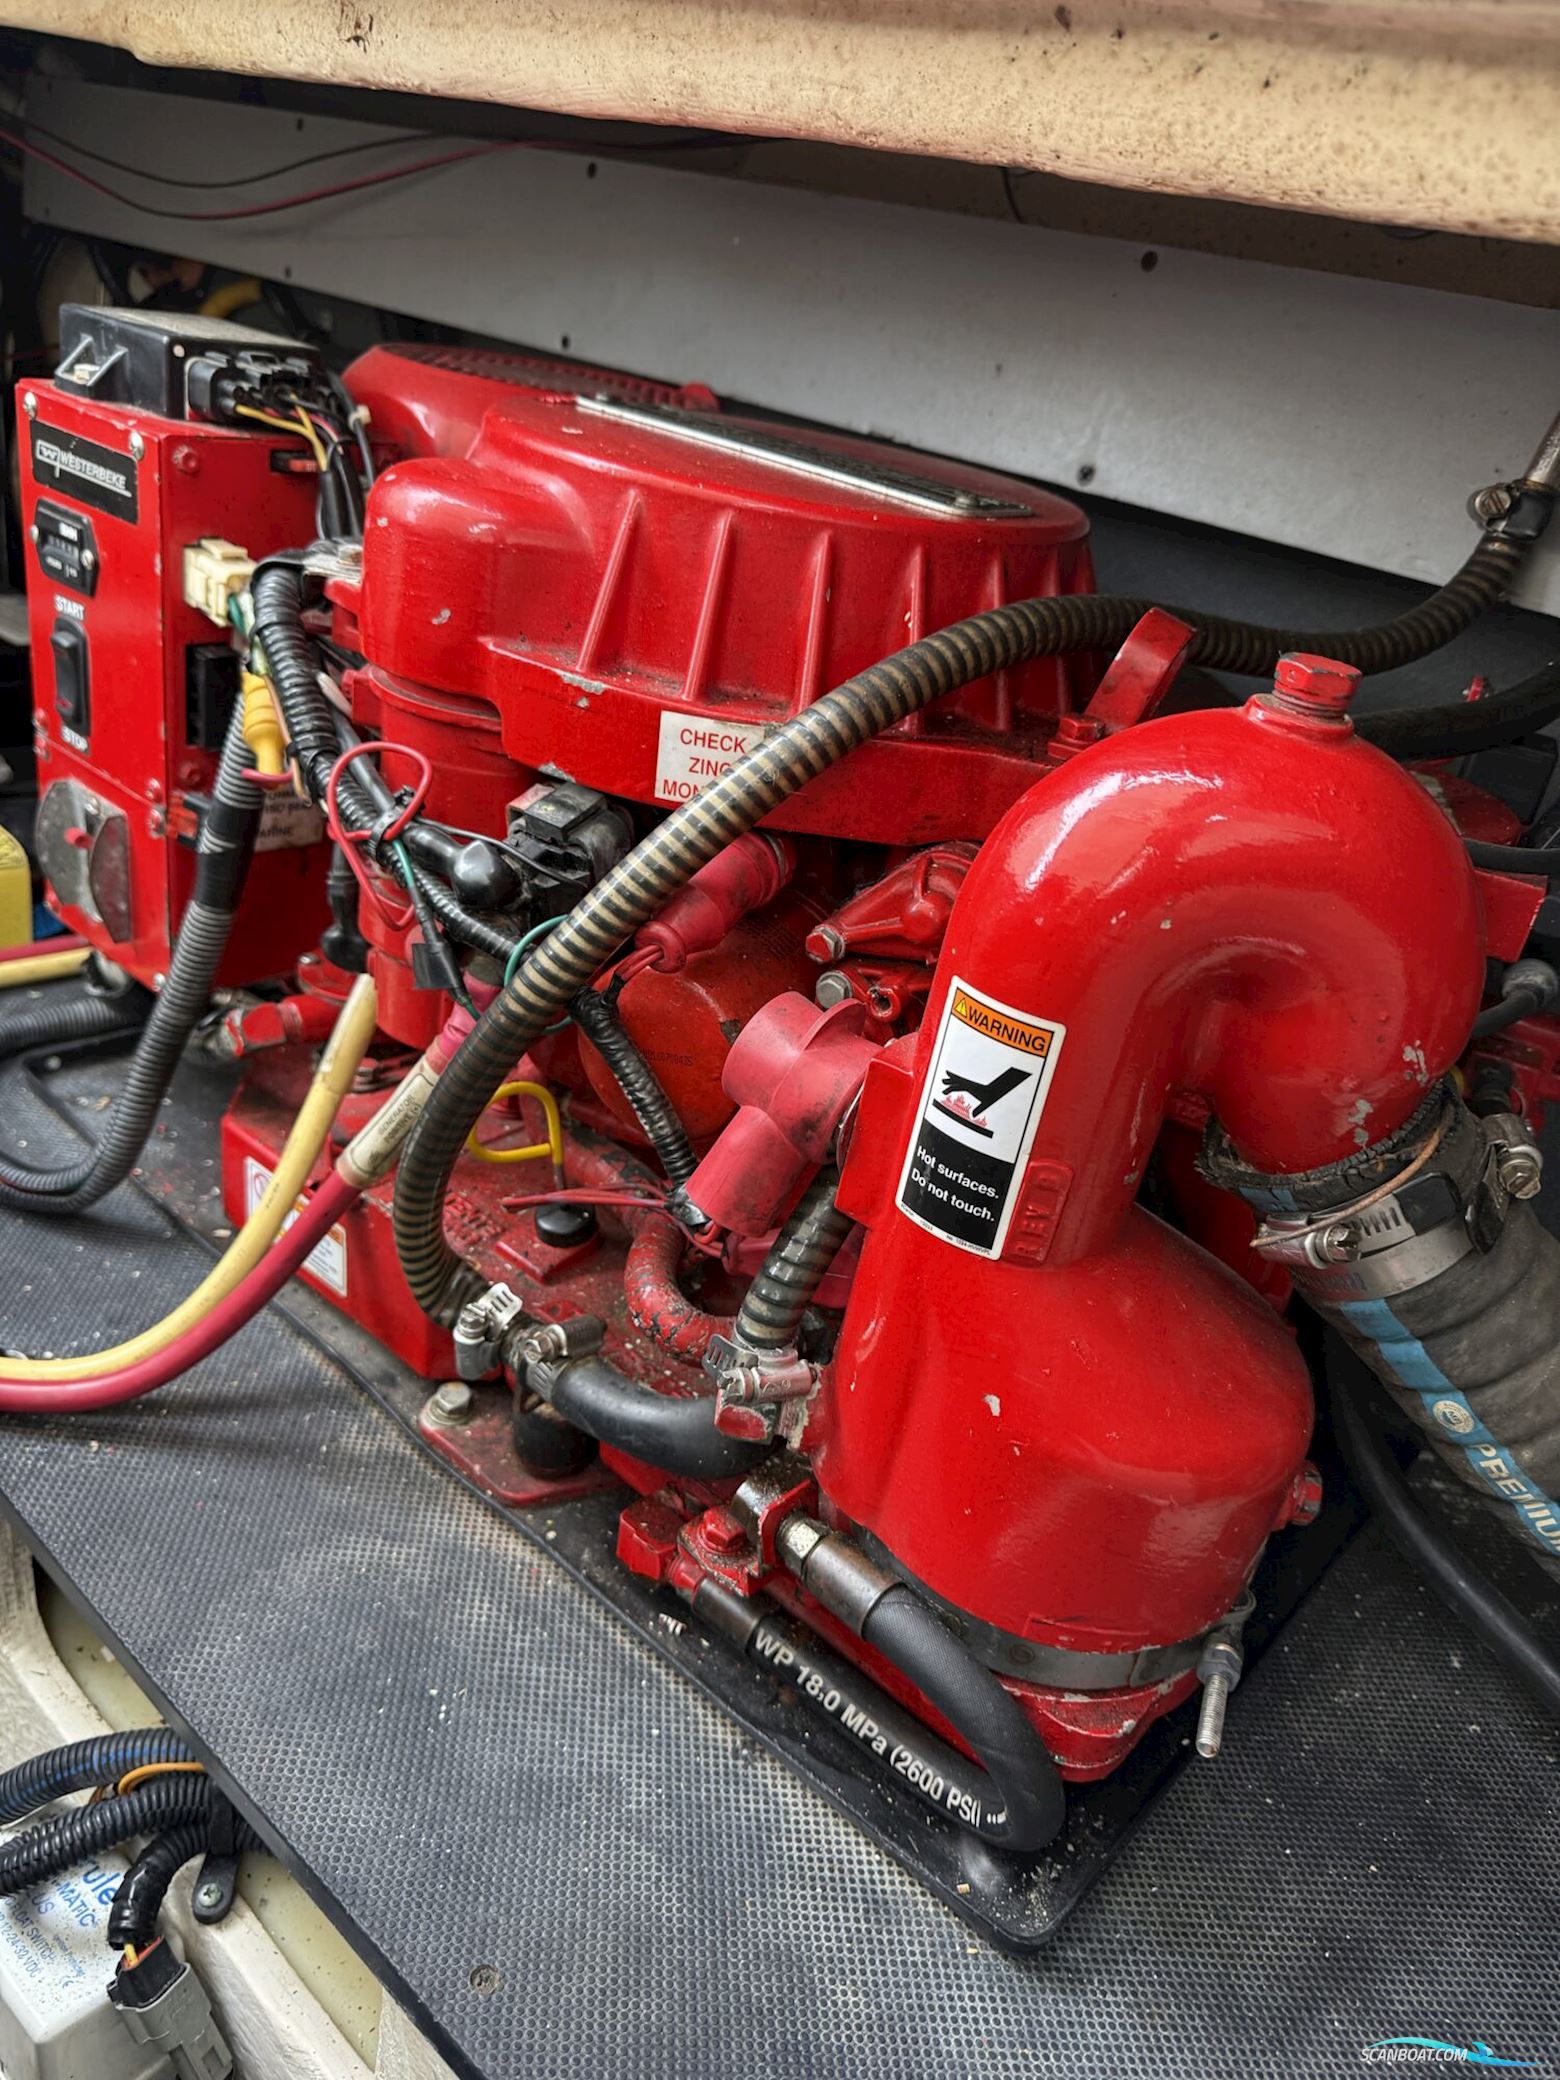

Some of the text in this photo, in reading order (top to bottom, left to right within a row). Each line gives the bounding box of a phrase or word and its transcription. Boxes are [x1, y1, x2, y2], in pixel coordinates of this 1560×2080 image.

[60, 450, 127, 490] WESTERBEKE
[54, 594, 85, 620] START
[62, 725, 88, 752] STOP
[680, 728, 747, 754] CHECK
[969, 1006, 1046, 1052] WARNING
[917, 1145, 999, 1199] Hot surfaces.
[911, 1167, 995, 1222] Do not touch.
[755, 1628, 794, 1665] WP
[840, 1703, 888, 1756] MPa
[889, 1743, 945, 1800] (2600
[81, 1859, 121, 1906] ule
[26, 1927, 57, 1960] SWITCH
[23, 1956, 41, 1978] VDC
